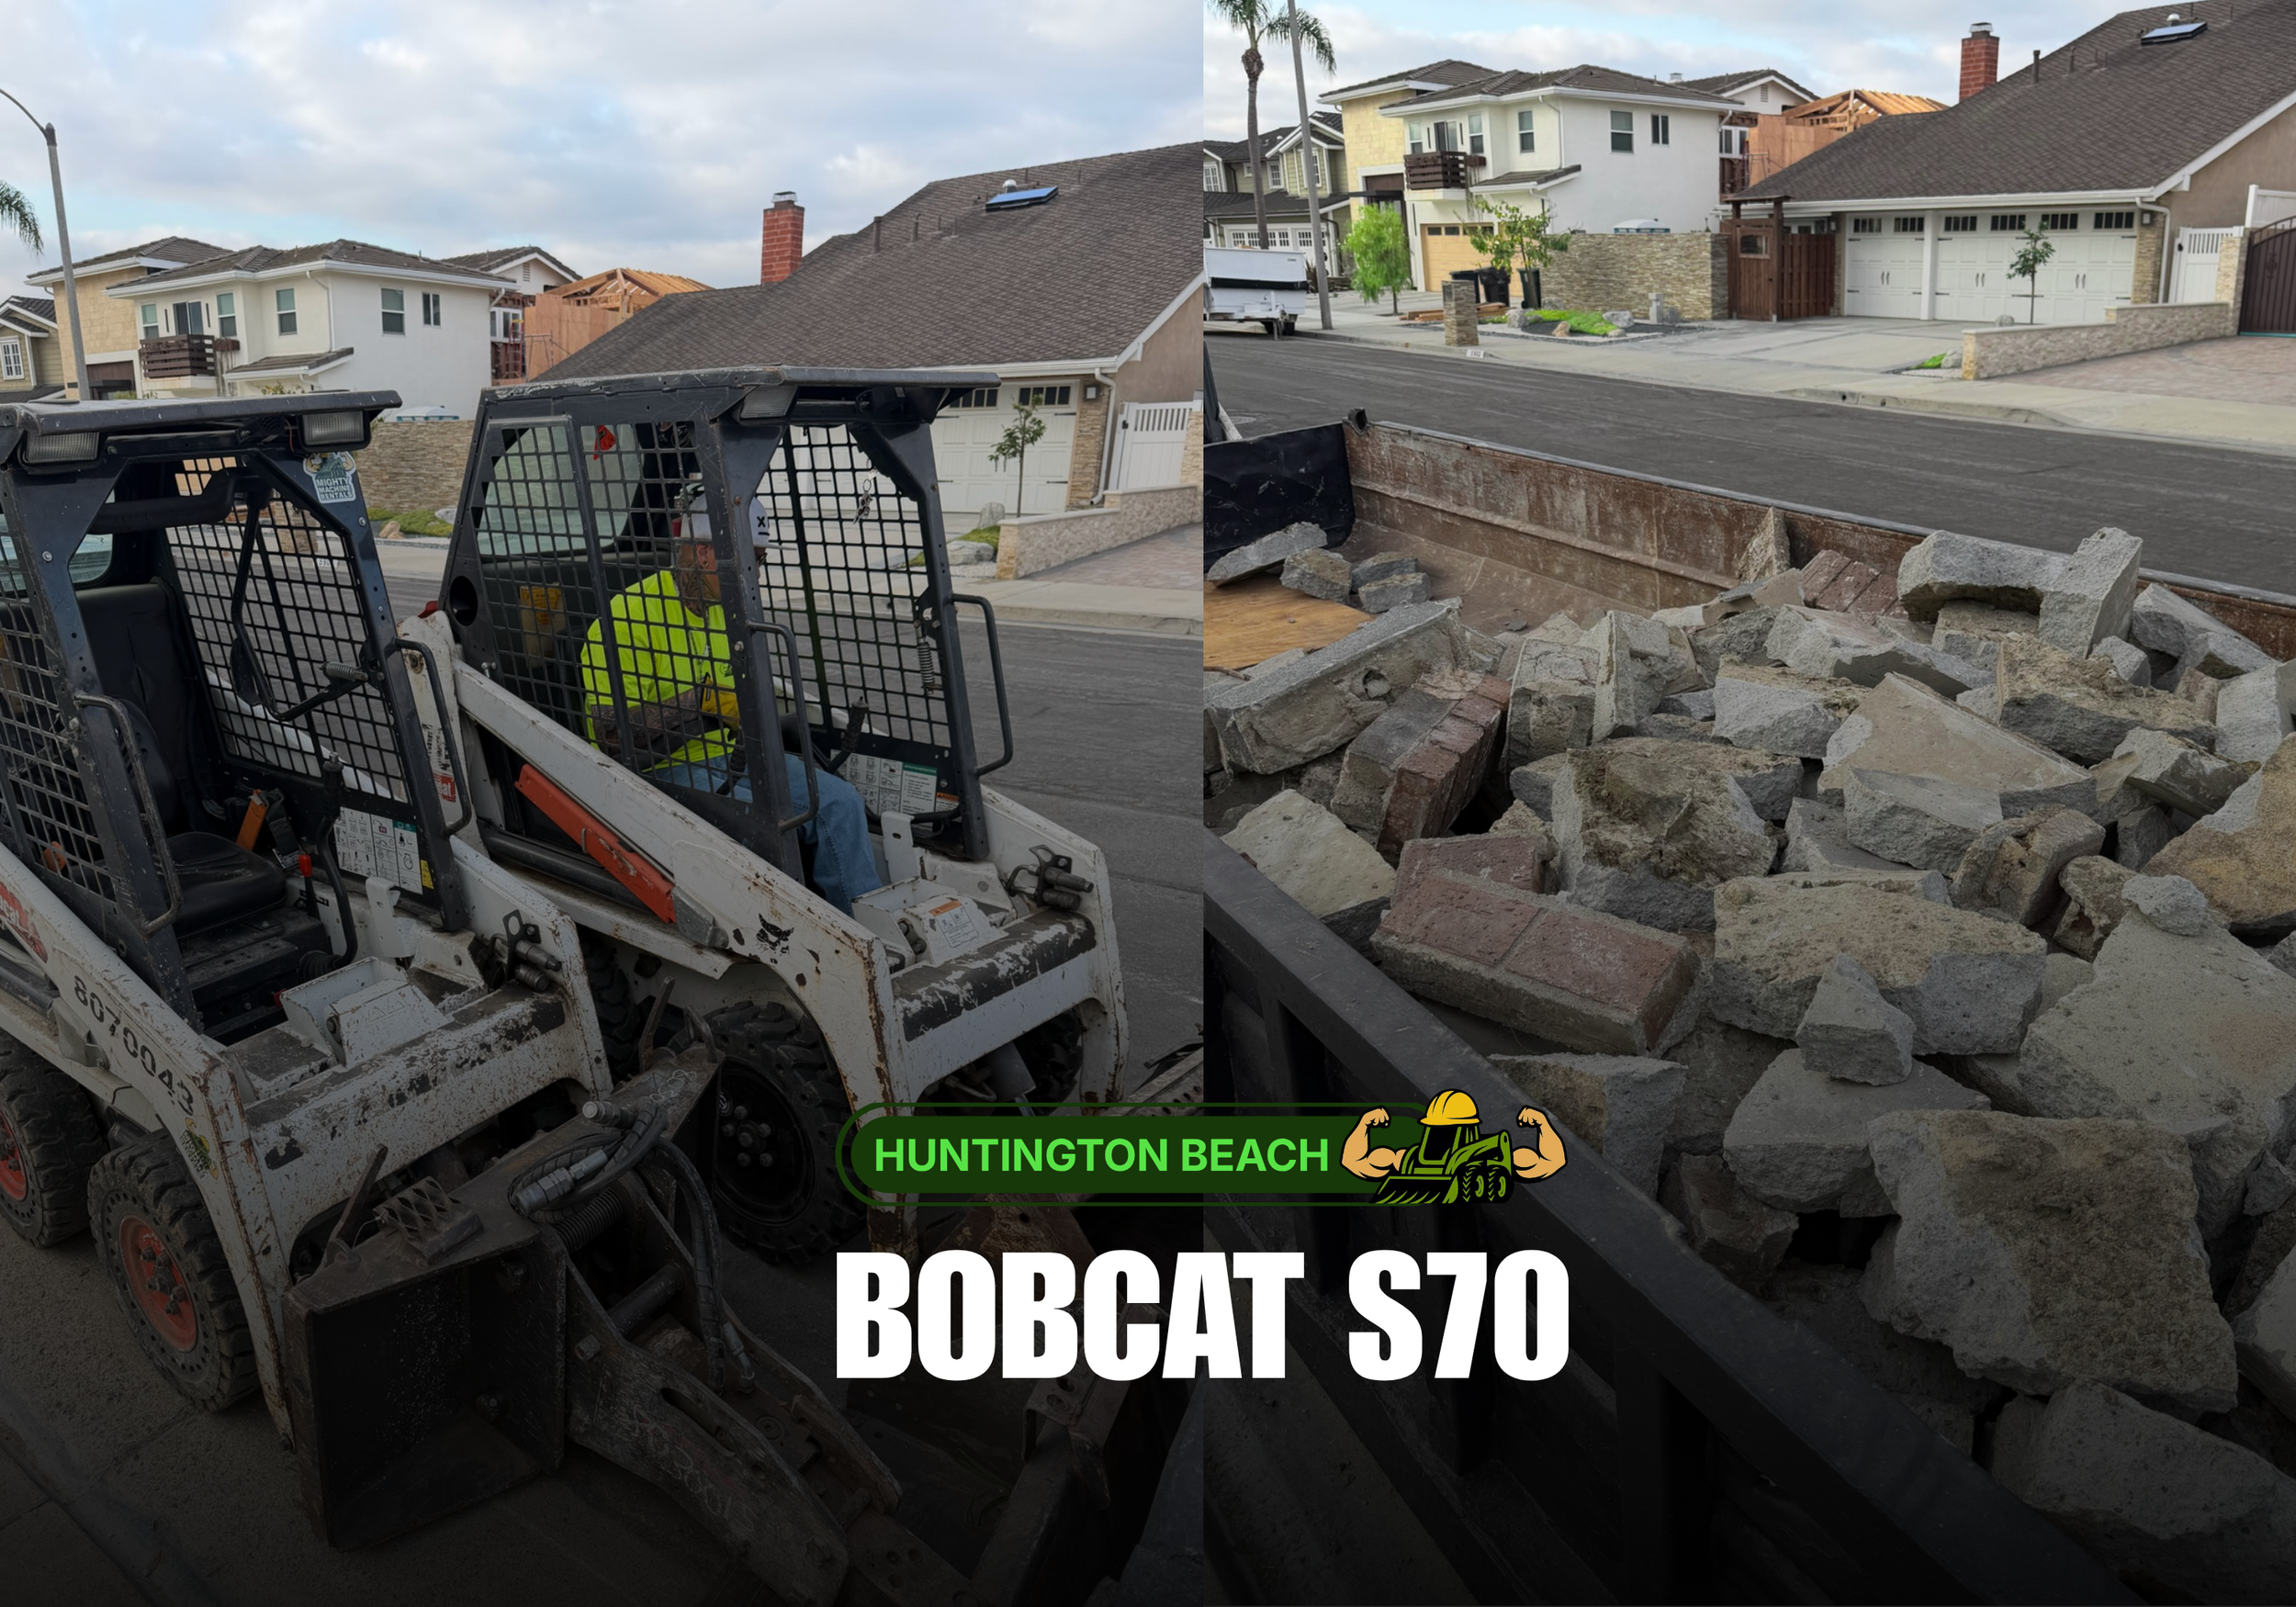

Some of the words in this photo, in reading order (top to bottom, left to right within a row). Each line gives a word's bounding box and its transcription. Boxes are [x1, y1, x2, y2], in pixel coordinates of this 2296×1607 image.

[316, 477, 349, 487] MIGHTY
[319, 485, 352, 493] MACHINE
[321, 491, 355, 500] RENTALS
[73, 975, 194, 1116] 8070043
